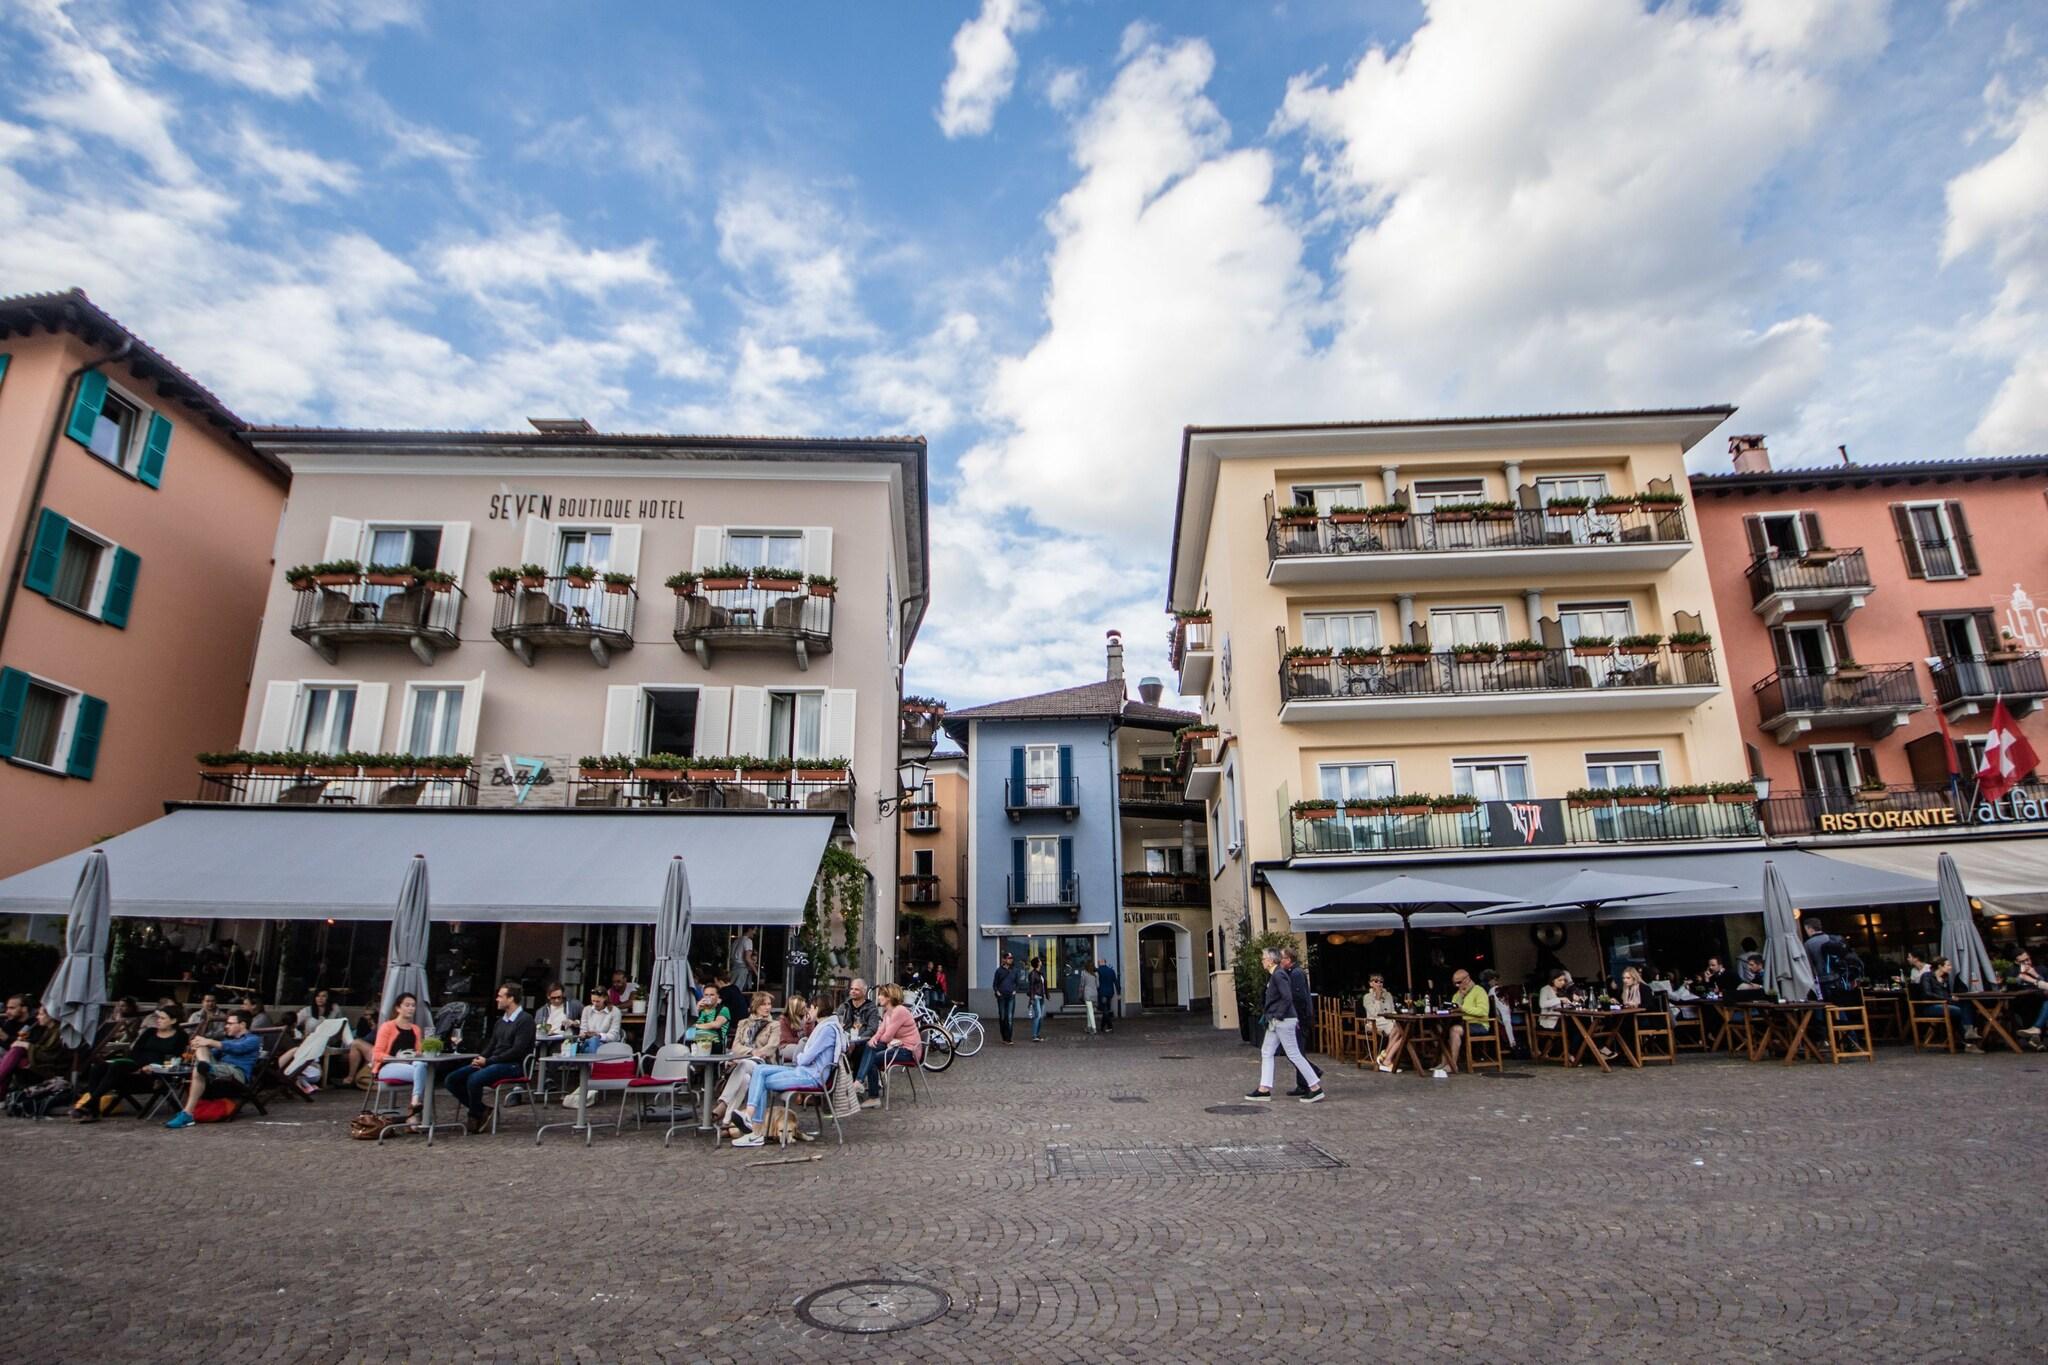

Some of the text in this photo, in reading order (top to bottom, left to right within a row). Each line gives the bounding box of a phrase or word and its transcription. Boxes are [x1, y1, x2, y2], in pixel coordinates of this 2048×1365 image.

[489, 494, 685, 520] SEVEN BOUTIQUE HOTEL
[1820, 807, 1957, 832] RISTORANTE
[1124, 912, 1143, 923] SEVEN
